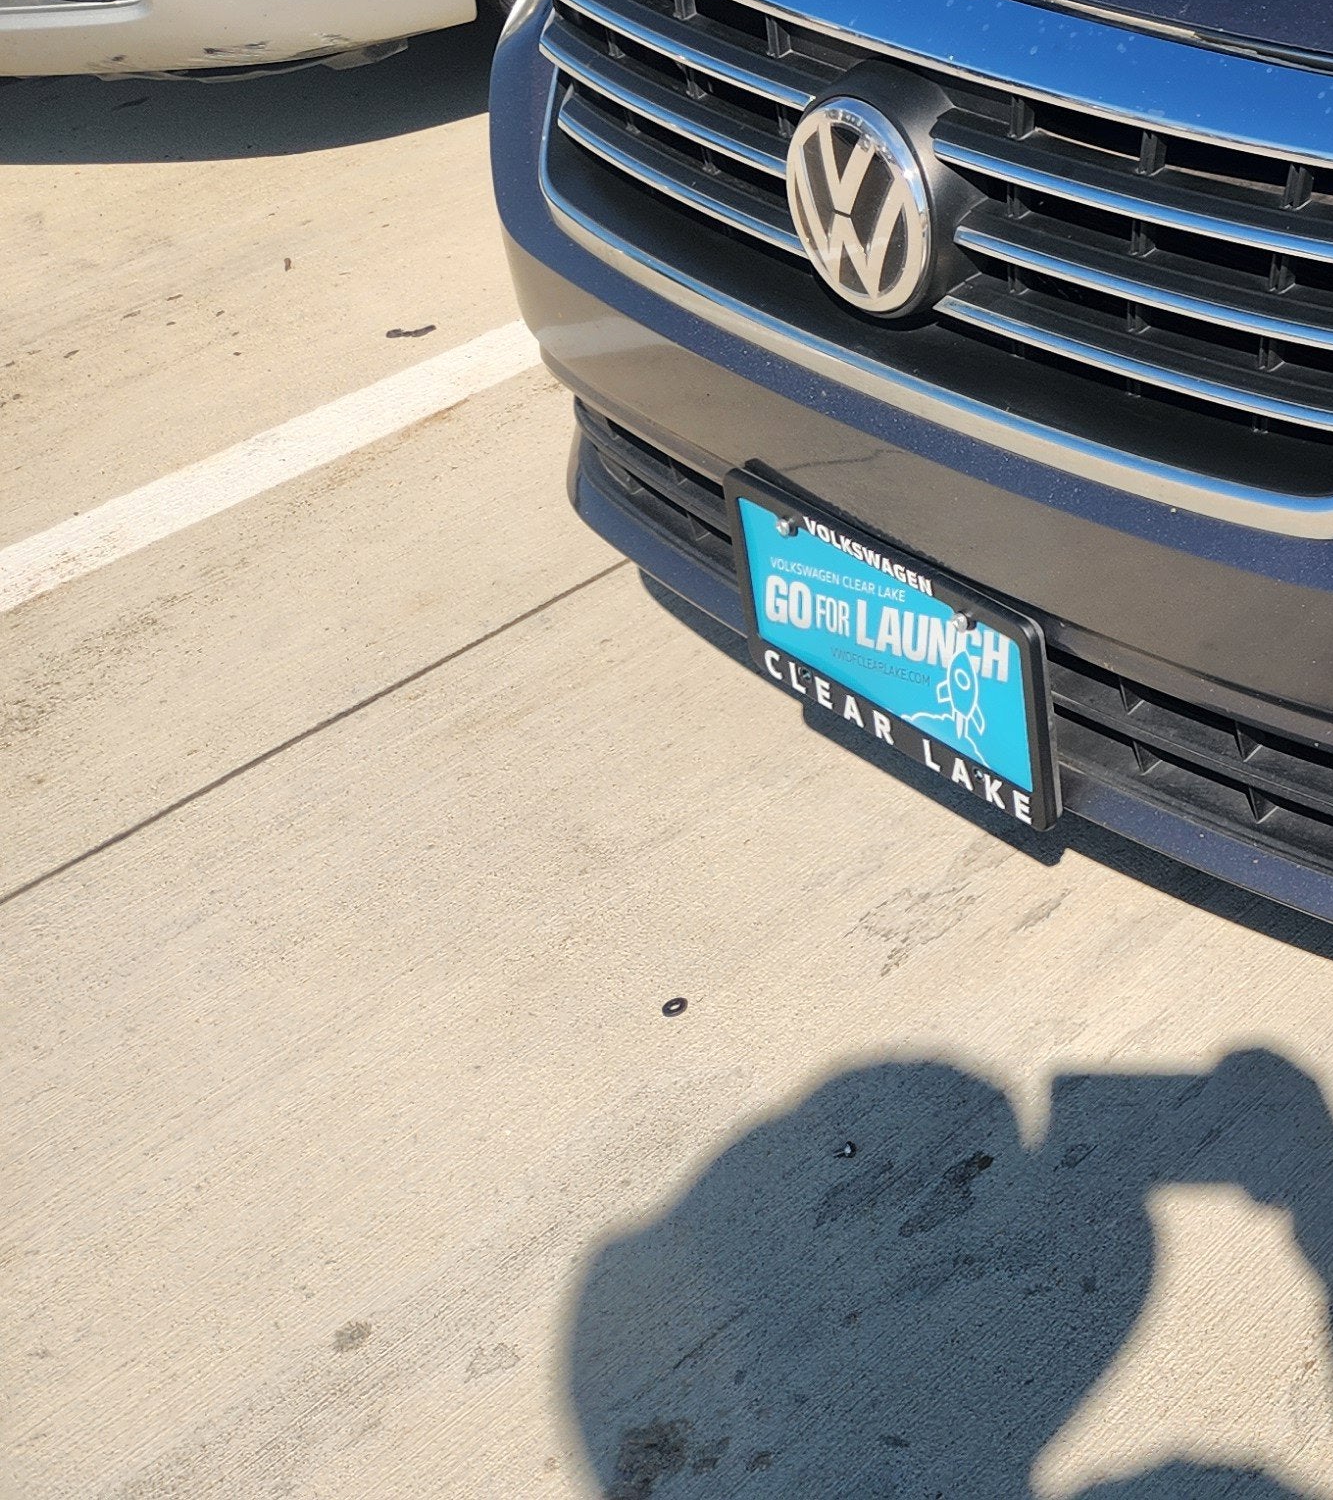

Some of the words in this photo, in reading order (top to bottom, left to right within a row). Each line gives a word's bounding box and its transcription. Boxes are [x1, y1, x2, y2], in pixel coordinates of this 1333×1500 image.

[770, 556, 840, 586] VOLKSWAGEN
[842, 576, 876, 595] CLEAR
[878, 585, 906, 603] LAKE
[802, 515, 934, 597] VOLKSWAGEN
[764, 575, 812, 630] GO
[815, 594, 850, 638] FOR
[856, 598, 1012, 683] LAUNCH
[764, 649, 895, 746] CLEAR
[922, 738, 1033, 825] LAKE
